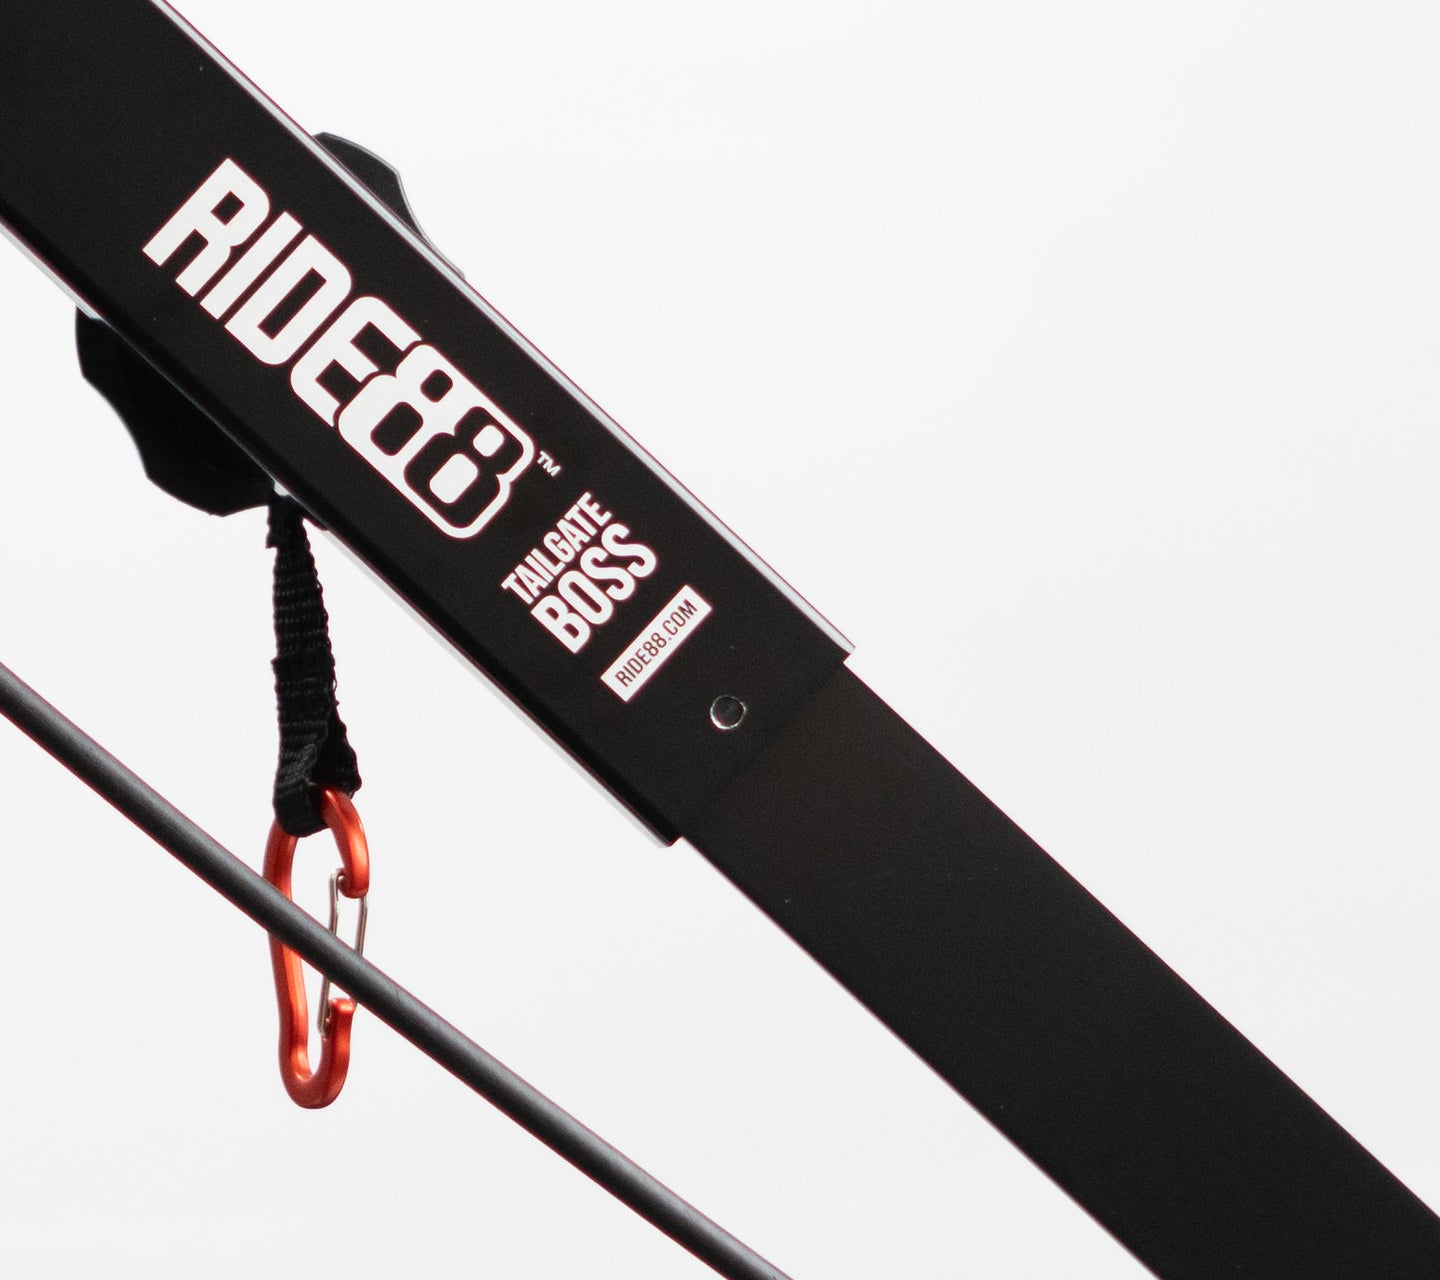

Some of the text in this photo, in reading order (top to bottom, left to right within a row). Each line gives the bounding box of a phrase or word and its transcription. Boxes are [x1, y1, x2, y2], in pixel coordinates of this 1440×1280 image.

[141, 157, 535, 539] RIDE88
[500, 490, 612, 605] TAILGATE
[530, 522, 658, 655] BOSS
[614, 598, 698, 687] RIDE88.COM
